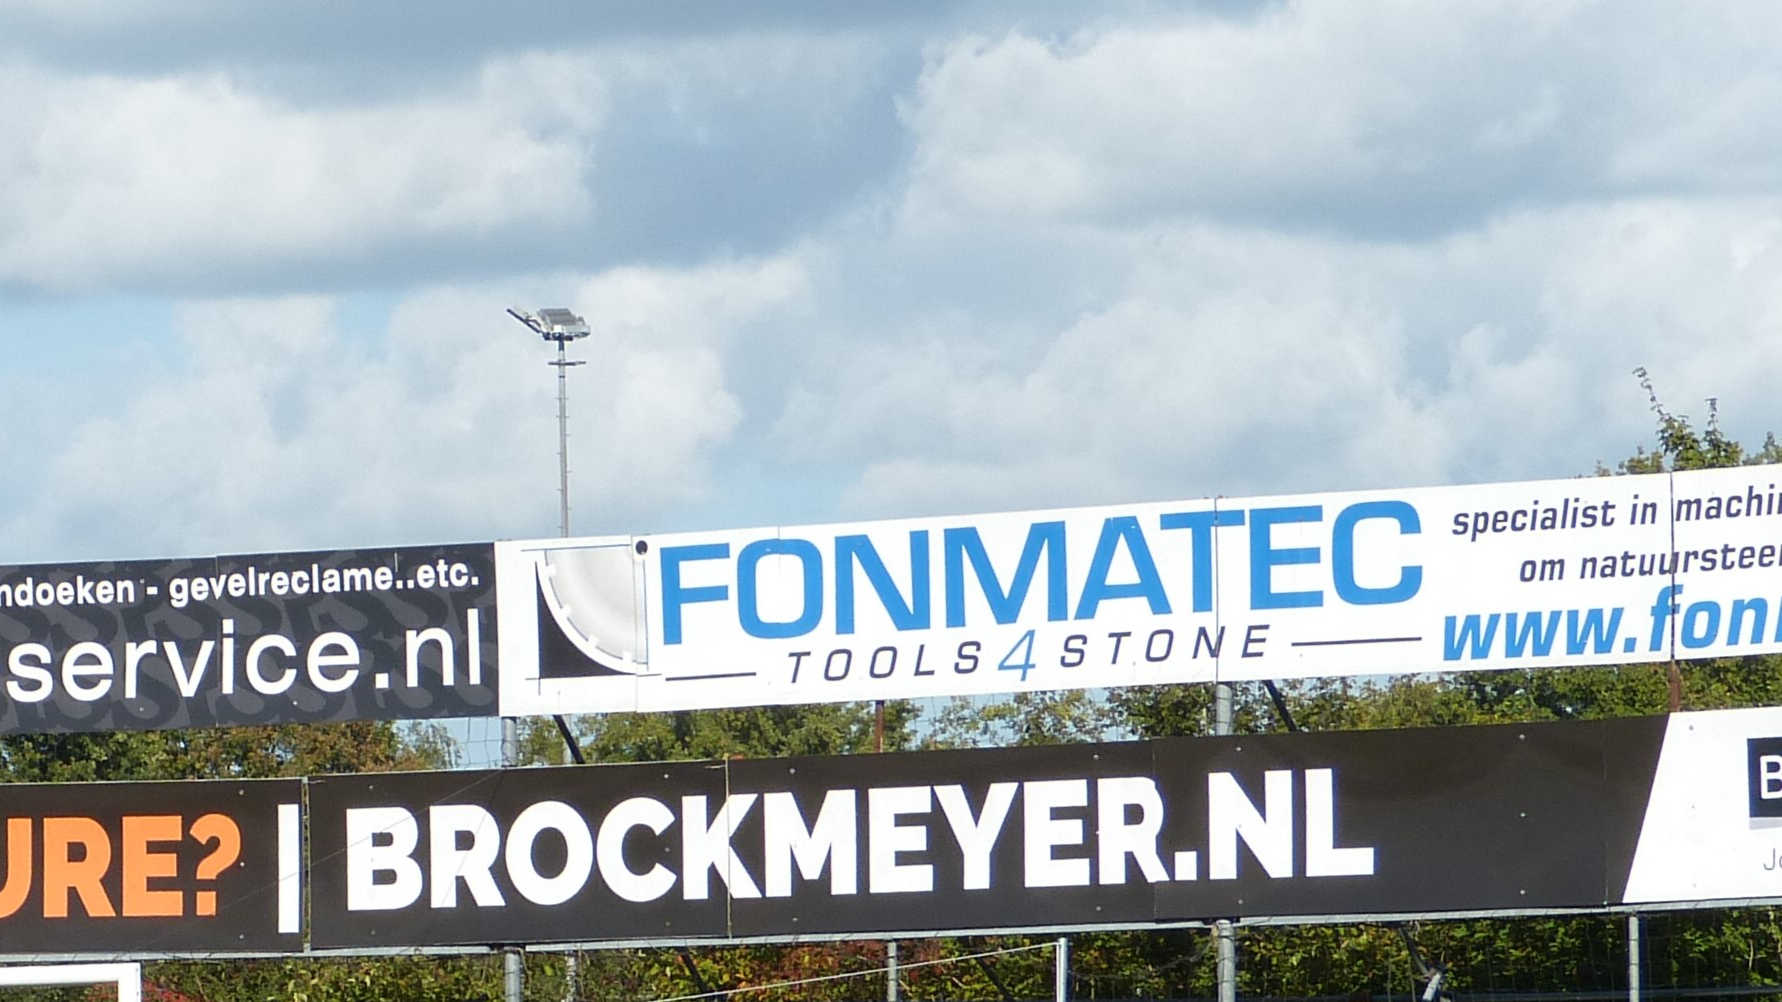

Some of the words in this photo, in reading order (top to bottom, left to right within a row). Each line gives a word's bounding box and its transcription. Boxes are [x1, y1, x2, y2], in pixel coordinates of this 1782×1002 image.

[1452, 498, 1616, 542] specialist
[1629, 494, 1658, 525] in
[1675, 483, 1782, 522] machi
[659, 500, 1423, 646] FONMATEC
[1520, 559, 1565, 583] om
[1580, 543, 1782, 580] natuurstee
[1443, 584, 1782, 661] www.fon
[347, 768, 1375, 911] BROCKMEYER.NL
